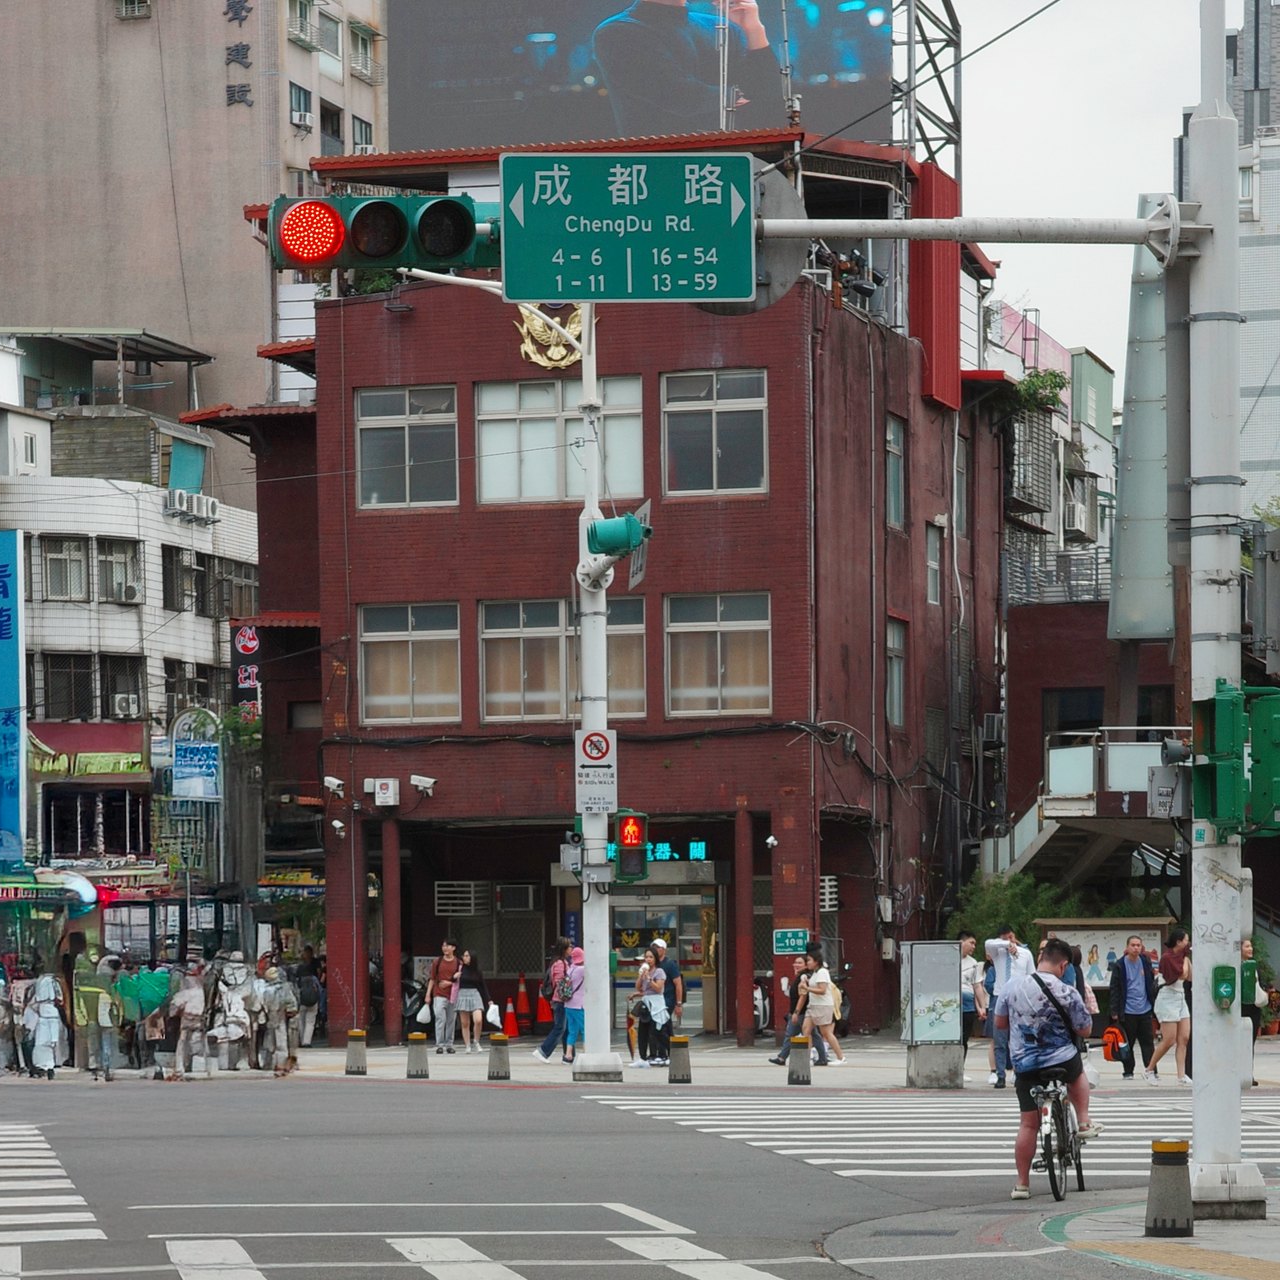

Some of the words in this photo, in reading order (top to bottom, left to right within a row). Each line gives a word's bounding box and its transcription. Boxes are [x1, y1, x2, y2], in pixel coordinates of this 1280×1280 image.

[531, 163, 724, 206] 成都路
[565, 215, 652, 237] ChengDu
[665, 215, 695, 232] Rd.
